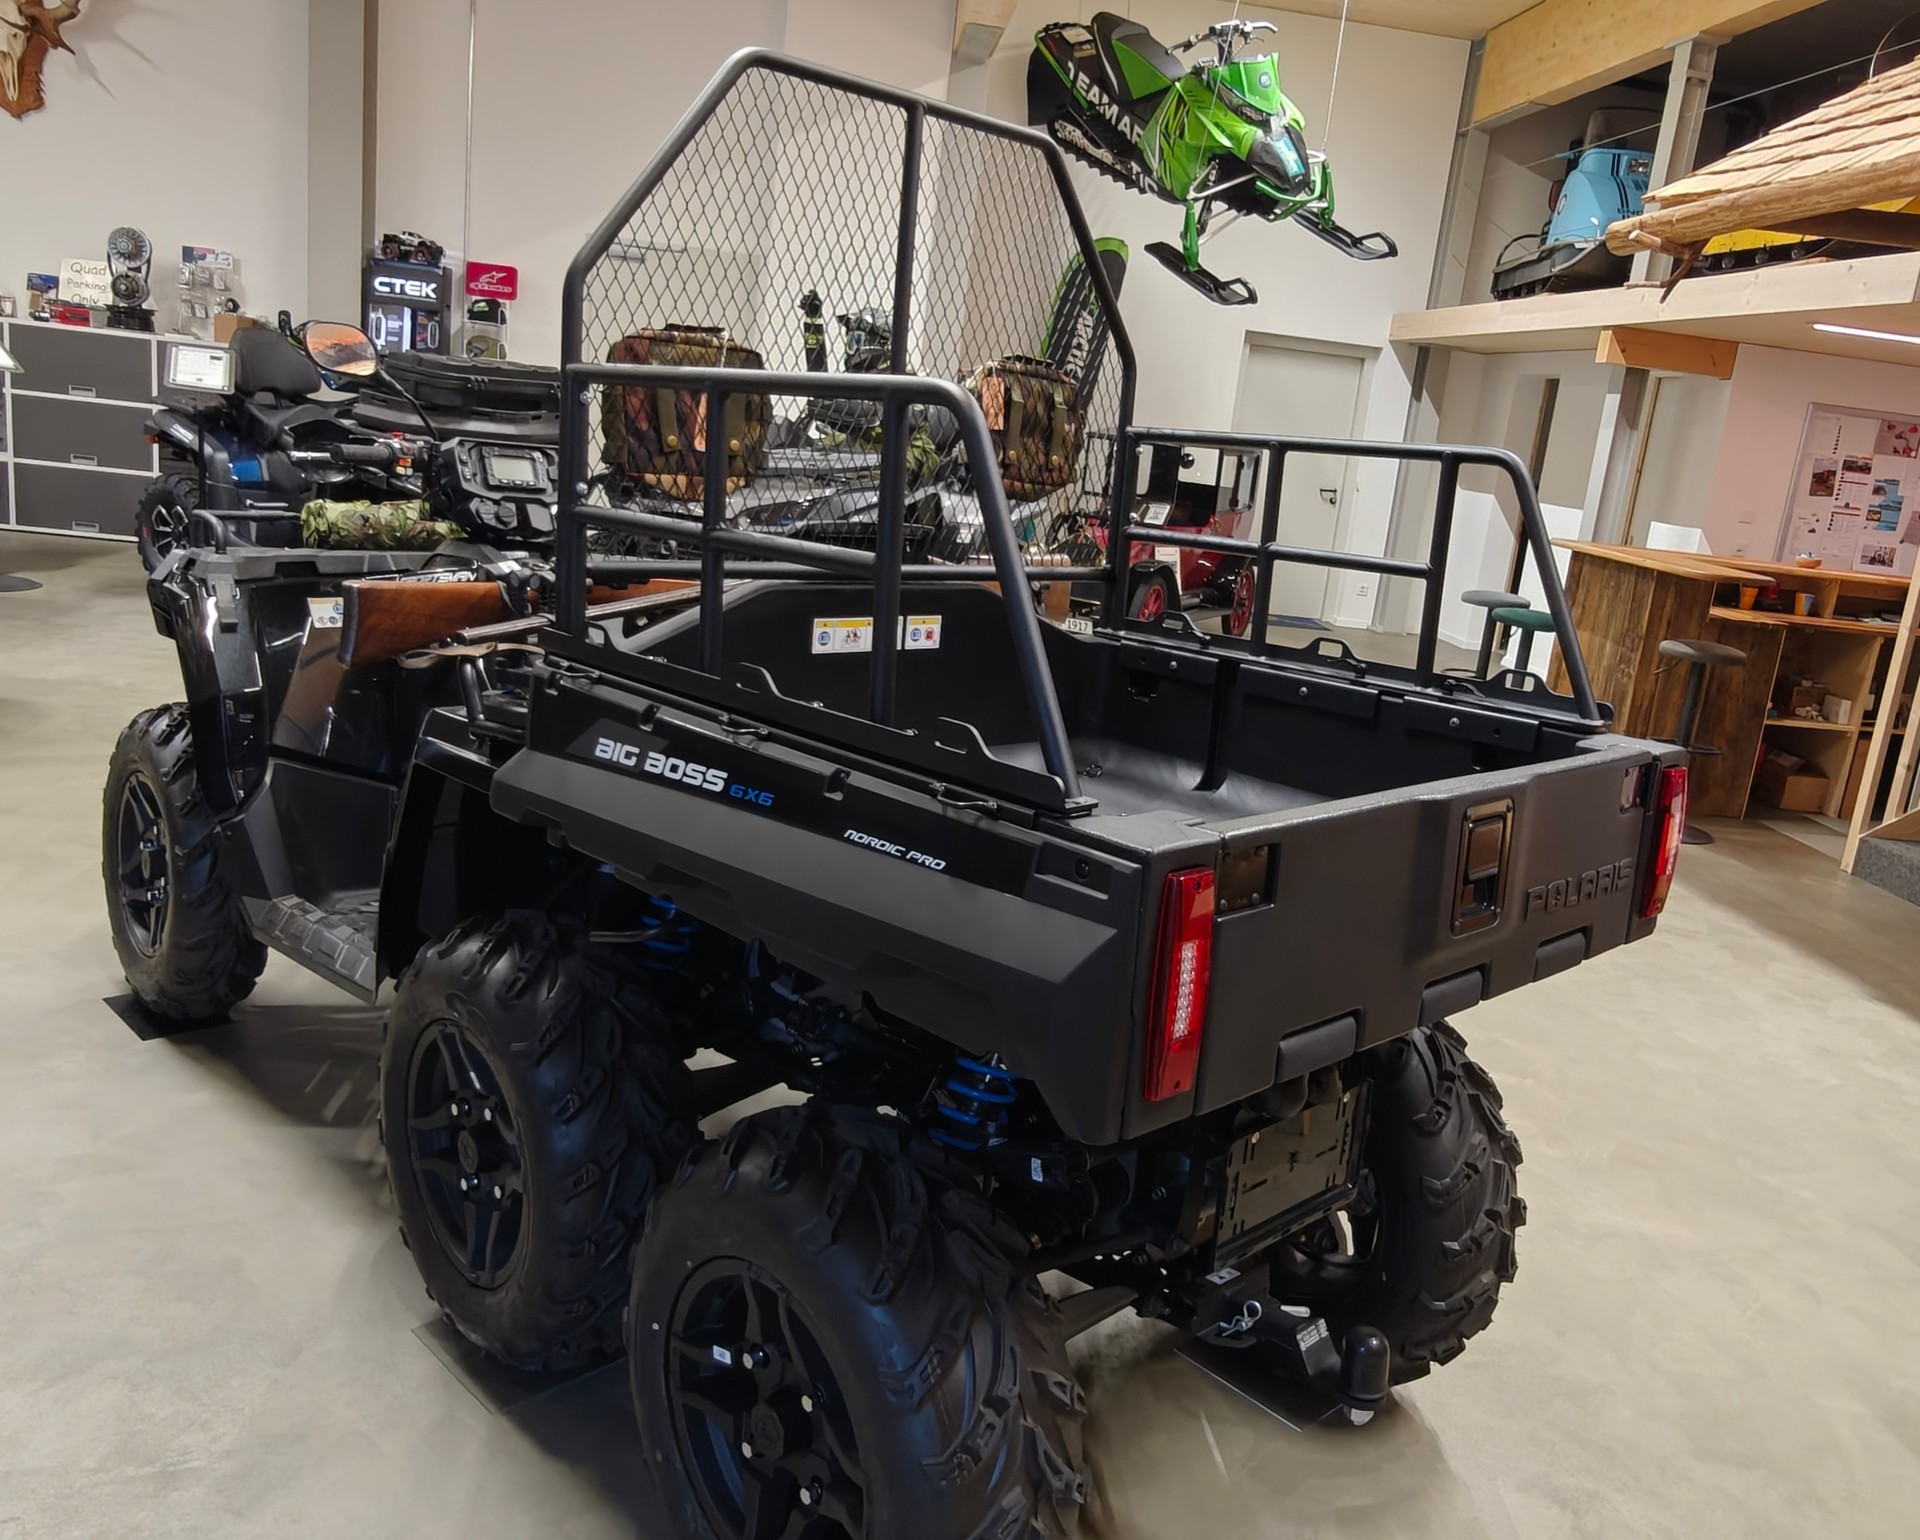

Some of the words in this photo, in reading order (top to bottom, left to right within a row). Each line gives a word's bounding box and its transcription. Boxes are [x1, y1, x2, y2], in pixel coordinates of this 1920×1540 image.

[1066, 60, 1120, 126] TEAM
[70, 261, 107, 276] Quad
[67, 278, 108, 294] Parking
[373, 276, 437, 299] CTEK
[71, 293, 100, 305] Only
[1067, 619, 1089, 632] 1917
[594, 737, 641, 767] BIG
[643, 751, 728, 793] BOSS
[843, 828, 906, 857] NORDIC
[905, 848, 947, 871] PRO
[1524, 857, 1633, 920] POLARIS
